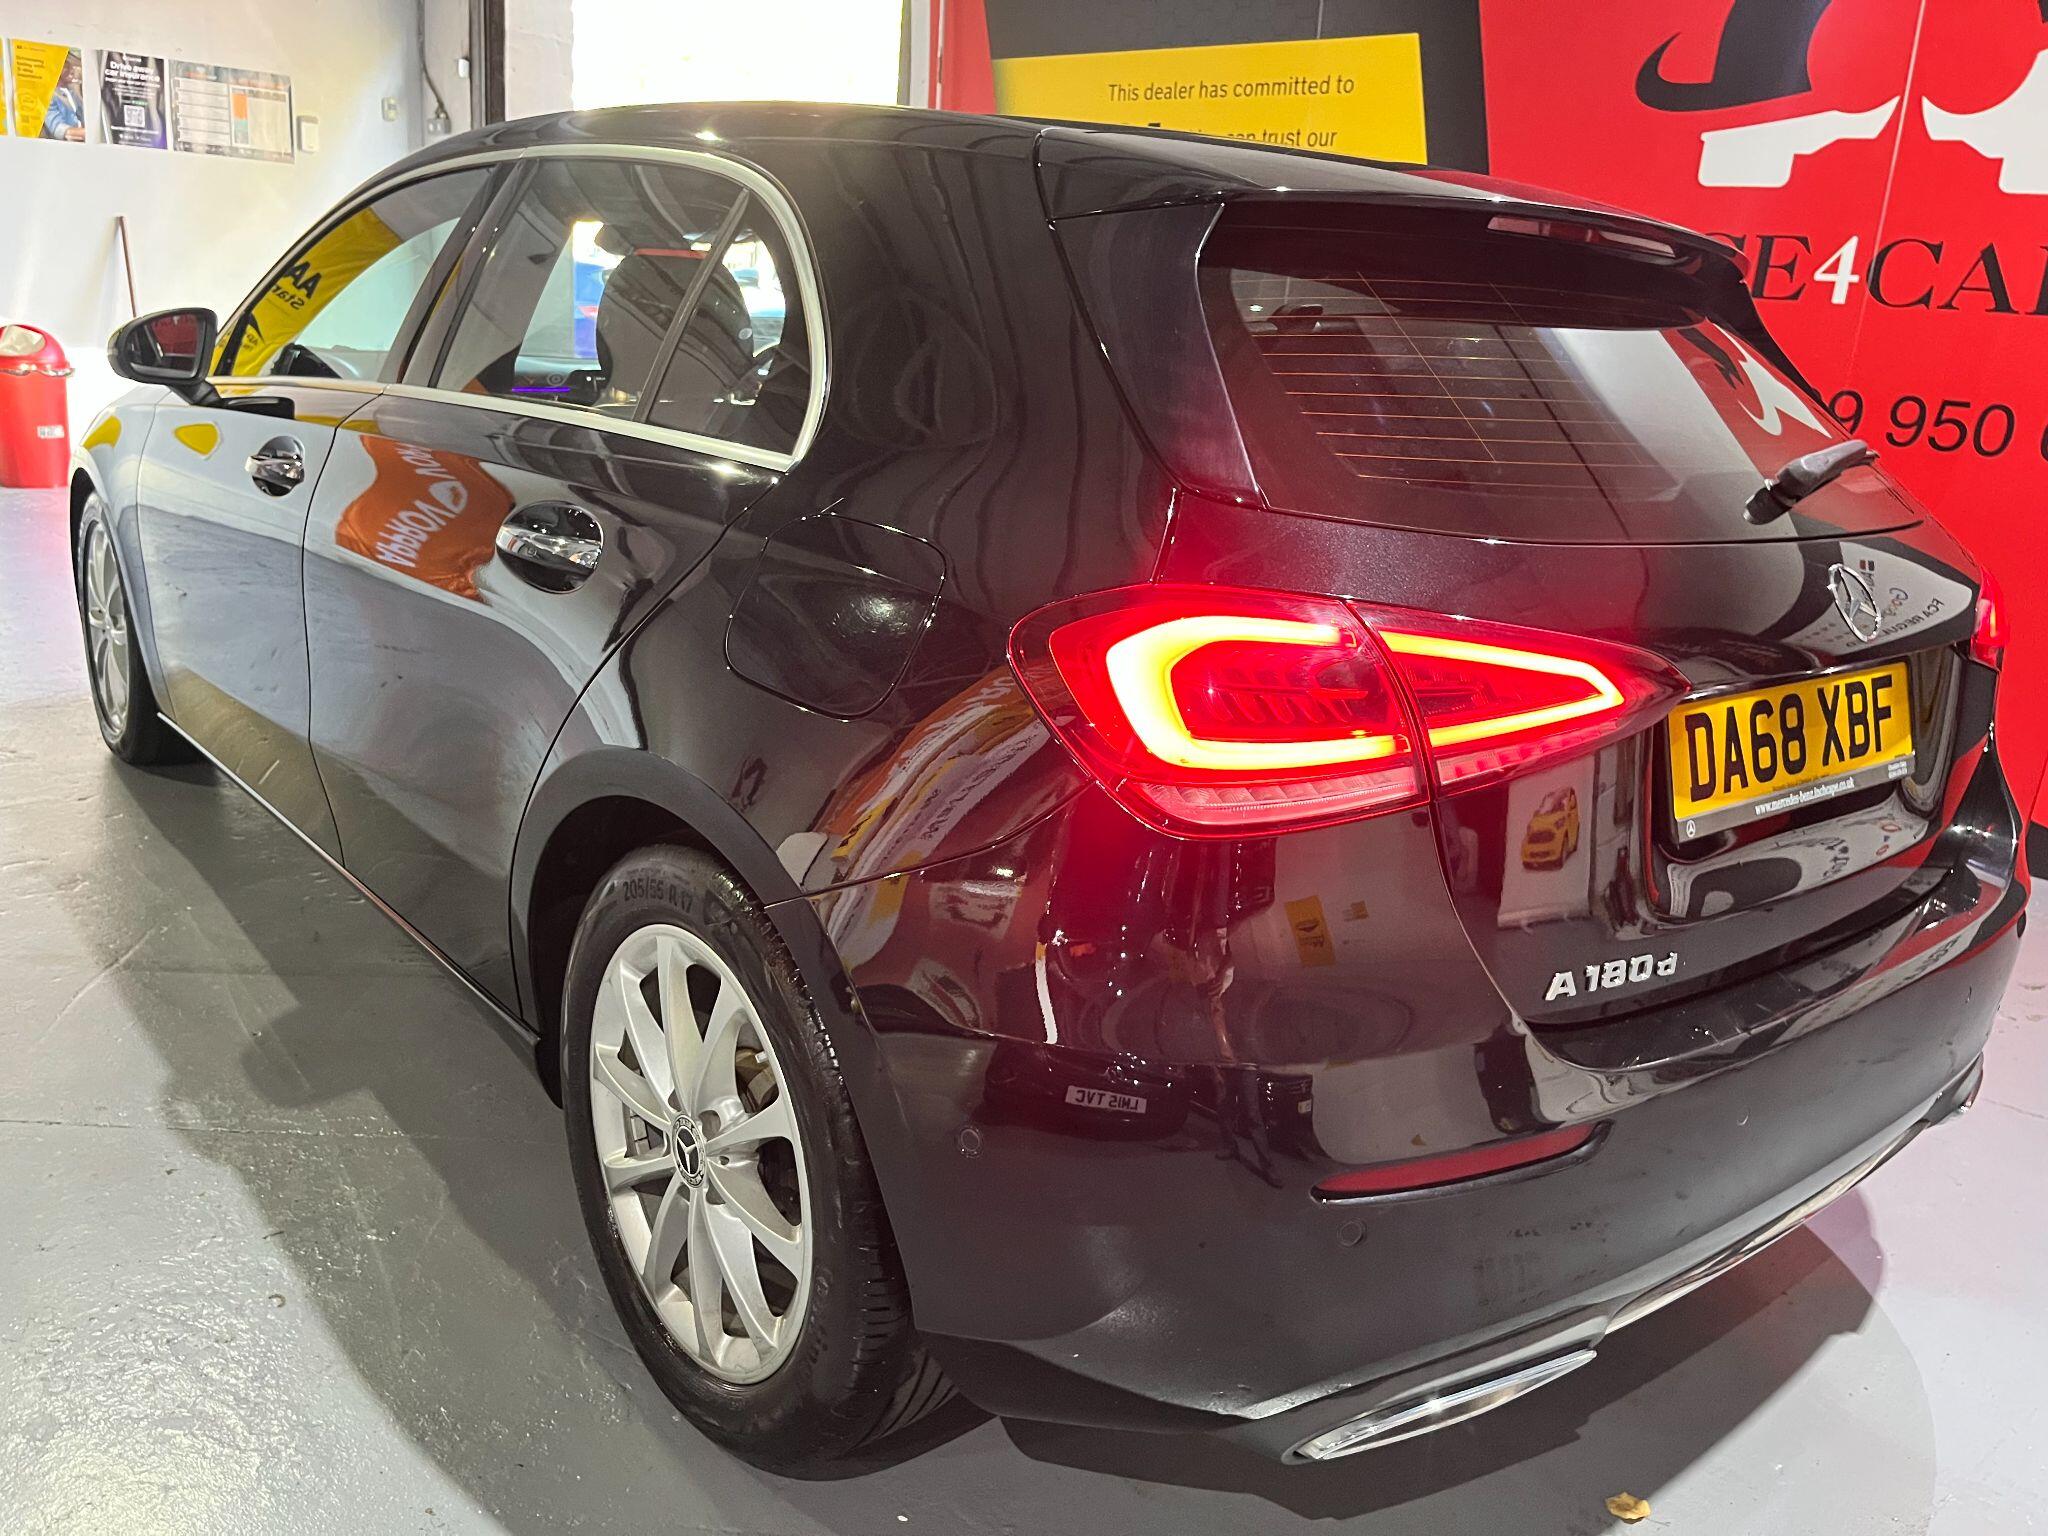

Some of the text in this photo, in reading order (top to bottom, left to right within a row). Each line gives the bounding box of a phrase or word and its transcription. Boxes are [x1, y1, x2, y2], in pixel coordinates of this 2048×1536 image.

[1108, 75, 1355, 102] This dealer has committed to
[1307, 131, 1338, 147] our
[1885, 394, 2016, 458] 950
[1685, 674, 1894, 803] DA68 XBF
[623, 876, 664, 902] 205/55
